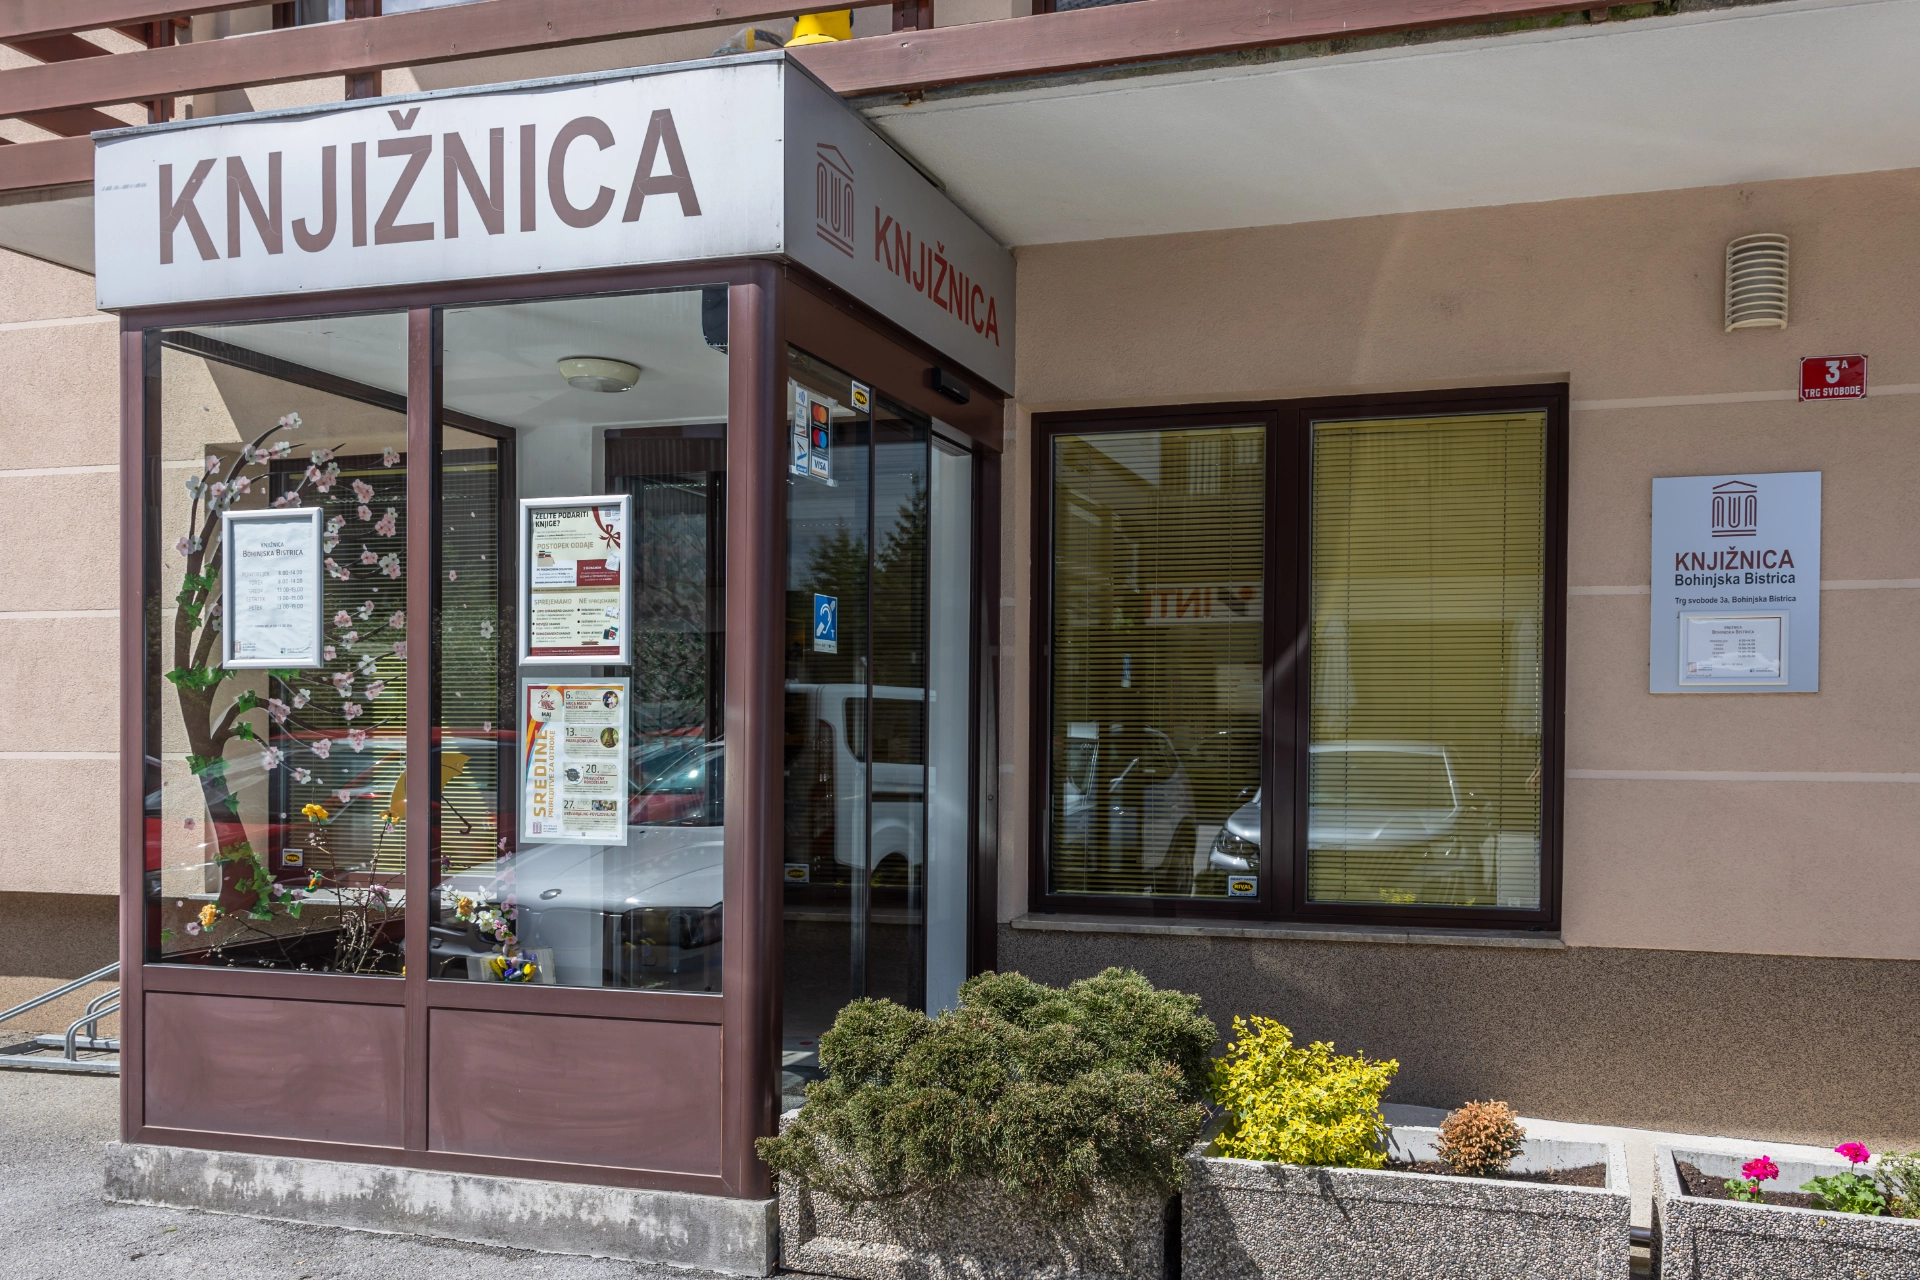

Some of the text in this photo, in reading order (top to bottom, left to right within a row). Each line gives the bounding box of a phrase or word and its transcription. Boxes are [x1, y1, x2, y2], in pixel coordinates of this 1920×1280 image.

[158, 107, 702, 265] KNJIŽNICA
[875, 205, 1000, 348] KNJIŽNICA
[1804, 386, 1860, 398] TRG SVOBODE
[814, 459, 827, 472] VISA
[535, 510, 588, 520] ŽELITE PODARITI
[535, 520, 560, 528] KNJIGE?
[1675, 546, 1795, 571] KNJIŽNICA
[1675, 572, 1795, 588] Bohinjska Bistrica
[1675, 598, 1686, 606] Trg
[1732, 596, 1767, 604] Bohinjska
[566, 691, 574, 699] 6.
[566, 728, 577, 736] 13.
[549, 762, 555, 772] ZA
[586, 764, 600, 773] 20.
[534, 730, 548, 817] SREDINE
[564, 800, 575, 809] 27.
